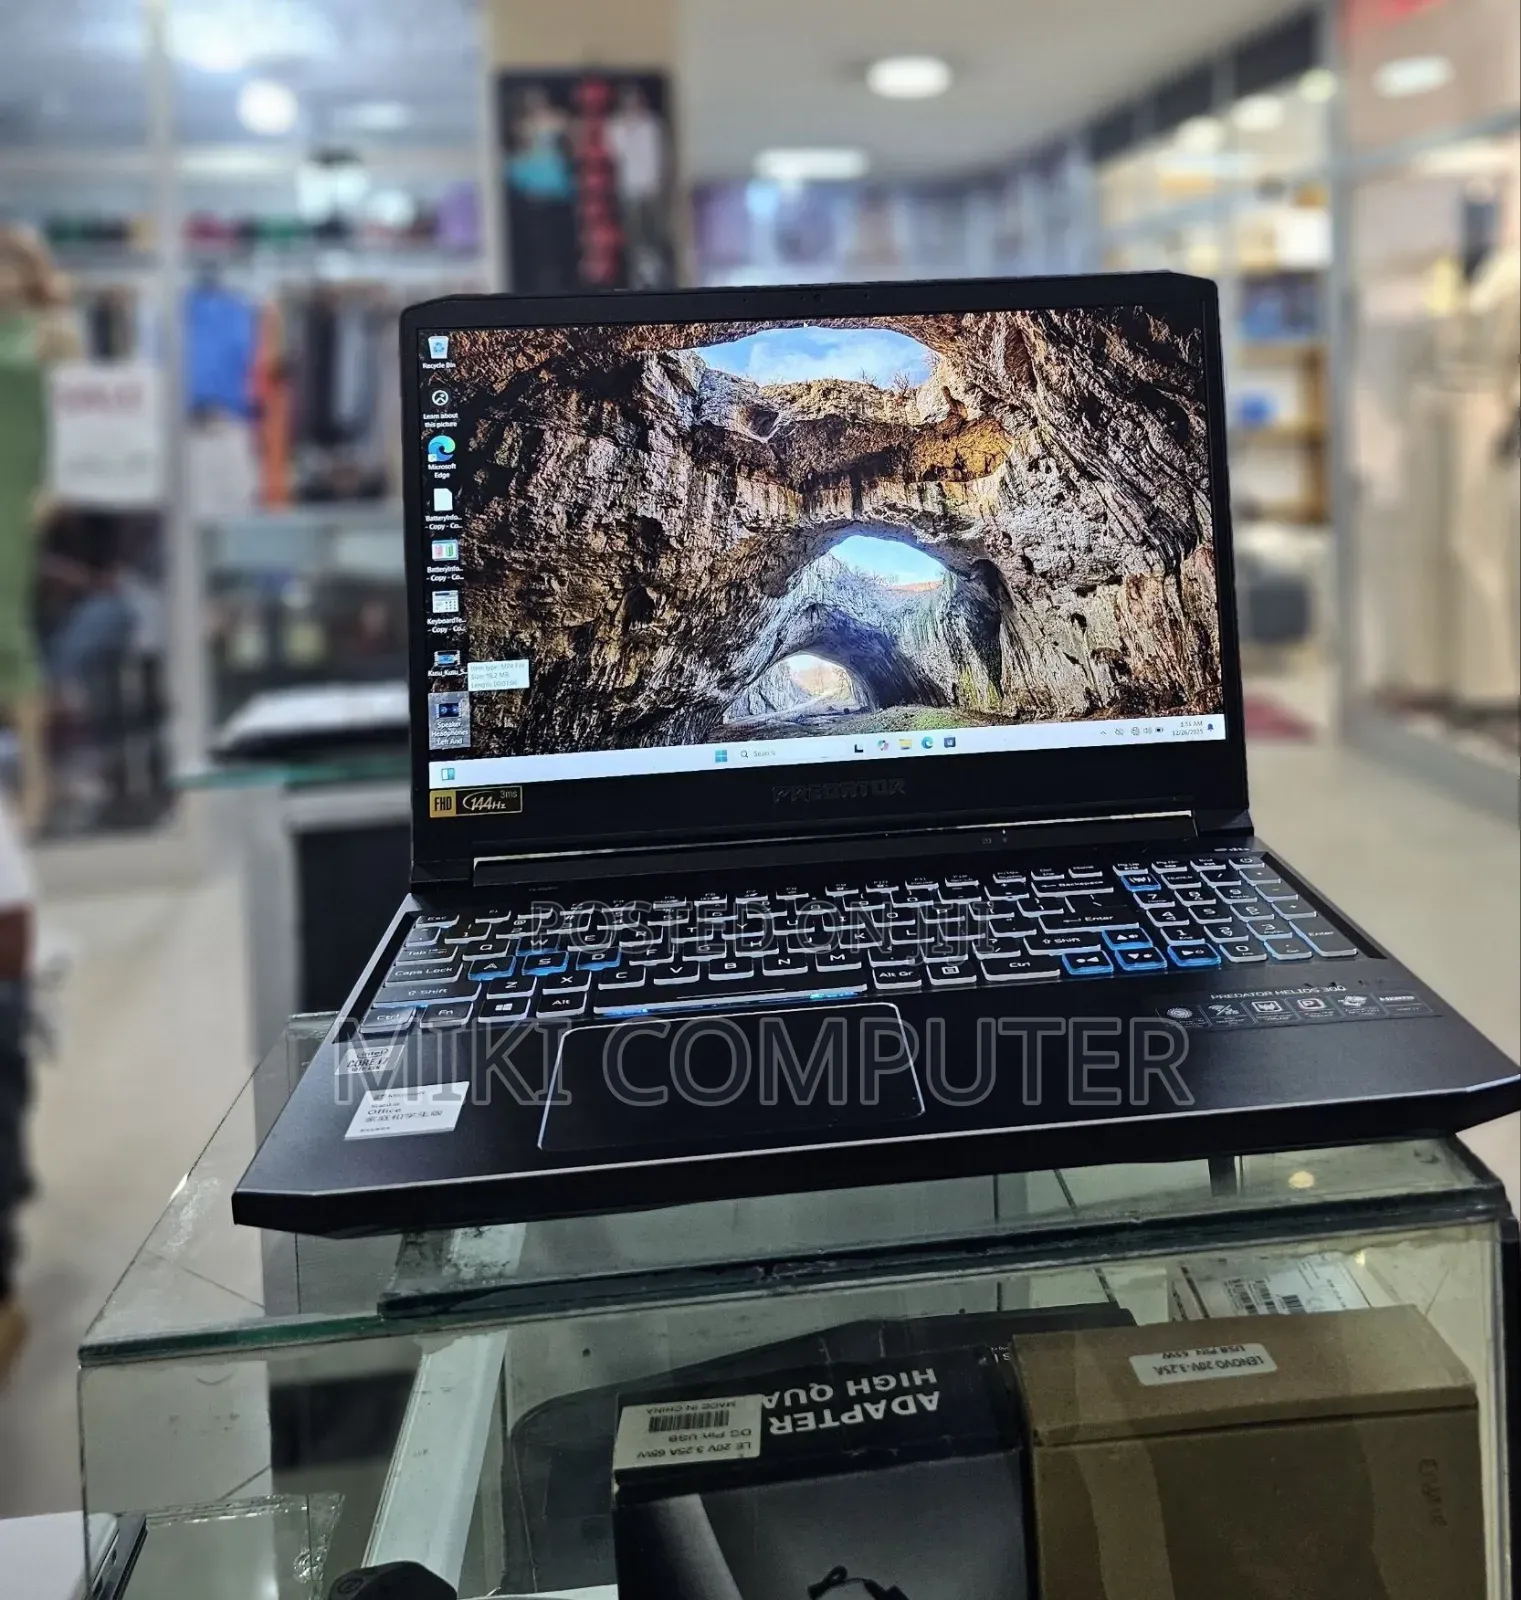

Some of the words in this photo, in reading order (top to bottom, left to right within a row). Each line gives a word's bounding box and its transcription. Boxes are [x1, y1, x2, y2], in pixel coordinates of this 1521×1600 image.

[422, 362, 445, 370] Recycle
[427, 462, 457, 470] Microsoft
[434, 471, 450, 480] Edge
[428, 523, 446, 531] Copy
[430, 574, 447, 582] Copy
[431, 626, 448, 634] Copy
[434, 796, 452, 811] FHD
[500, 790, 518, 799] 3ms
[1084, 914, 1114, 922] Enter
[1053, 936, 1081, 944] Shift
[394, 970, 423, 978] Caps
[425, 966, 453, 974] Lock
[420, 987, 449, 995] Shift
[1210, 989, 1274, 1000] PREDATOR
[1274, 986, 1320, 996] HELIOS
[1323, 984, 1348, 993] 300
[376, 1013, 401, 1021] Ctrl
[346, 1059, 379, 1068] CORE
[367, 1107, 402, 1115] Office
[1215, 1355, 1265, 1370] LENOVO
[845, 1367, 938, 1397] HIGH
[685, 1403, 698, 1411] IN
[701, 1400, 737, 1409] MADE
[646, 1406, 682, 1415] CHINA
[768, 1390, 941, 1436] ADAPTER
[729, 1428, 752, 1438] DC
[668, 1434, 699, 1443] USB
[707, 1443, 732, 1452] 20V
[736, 1441, 753, 1450] LE
